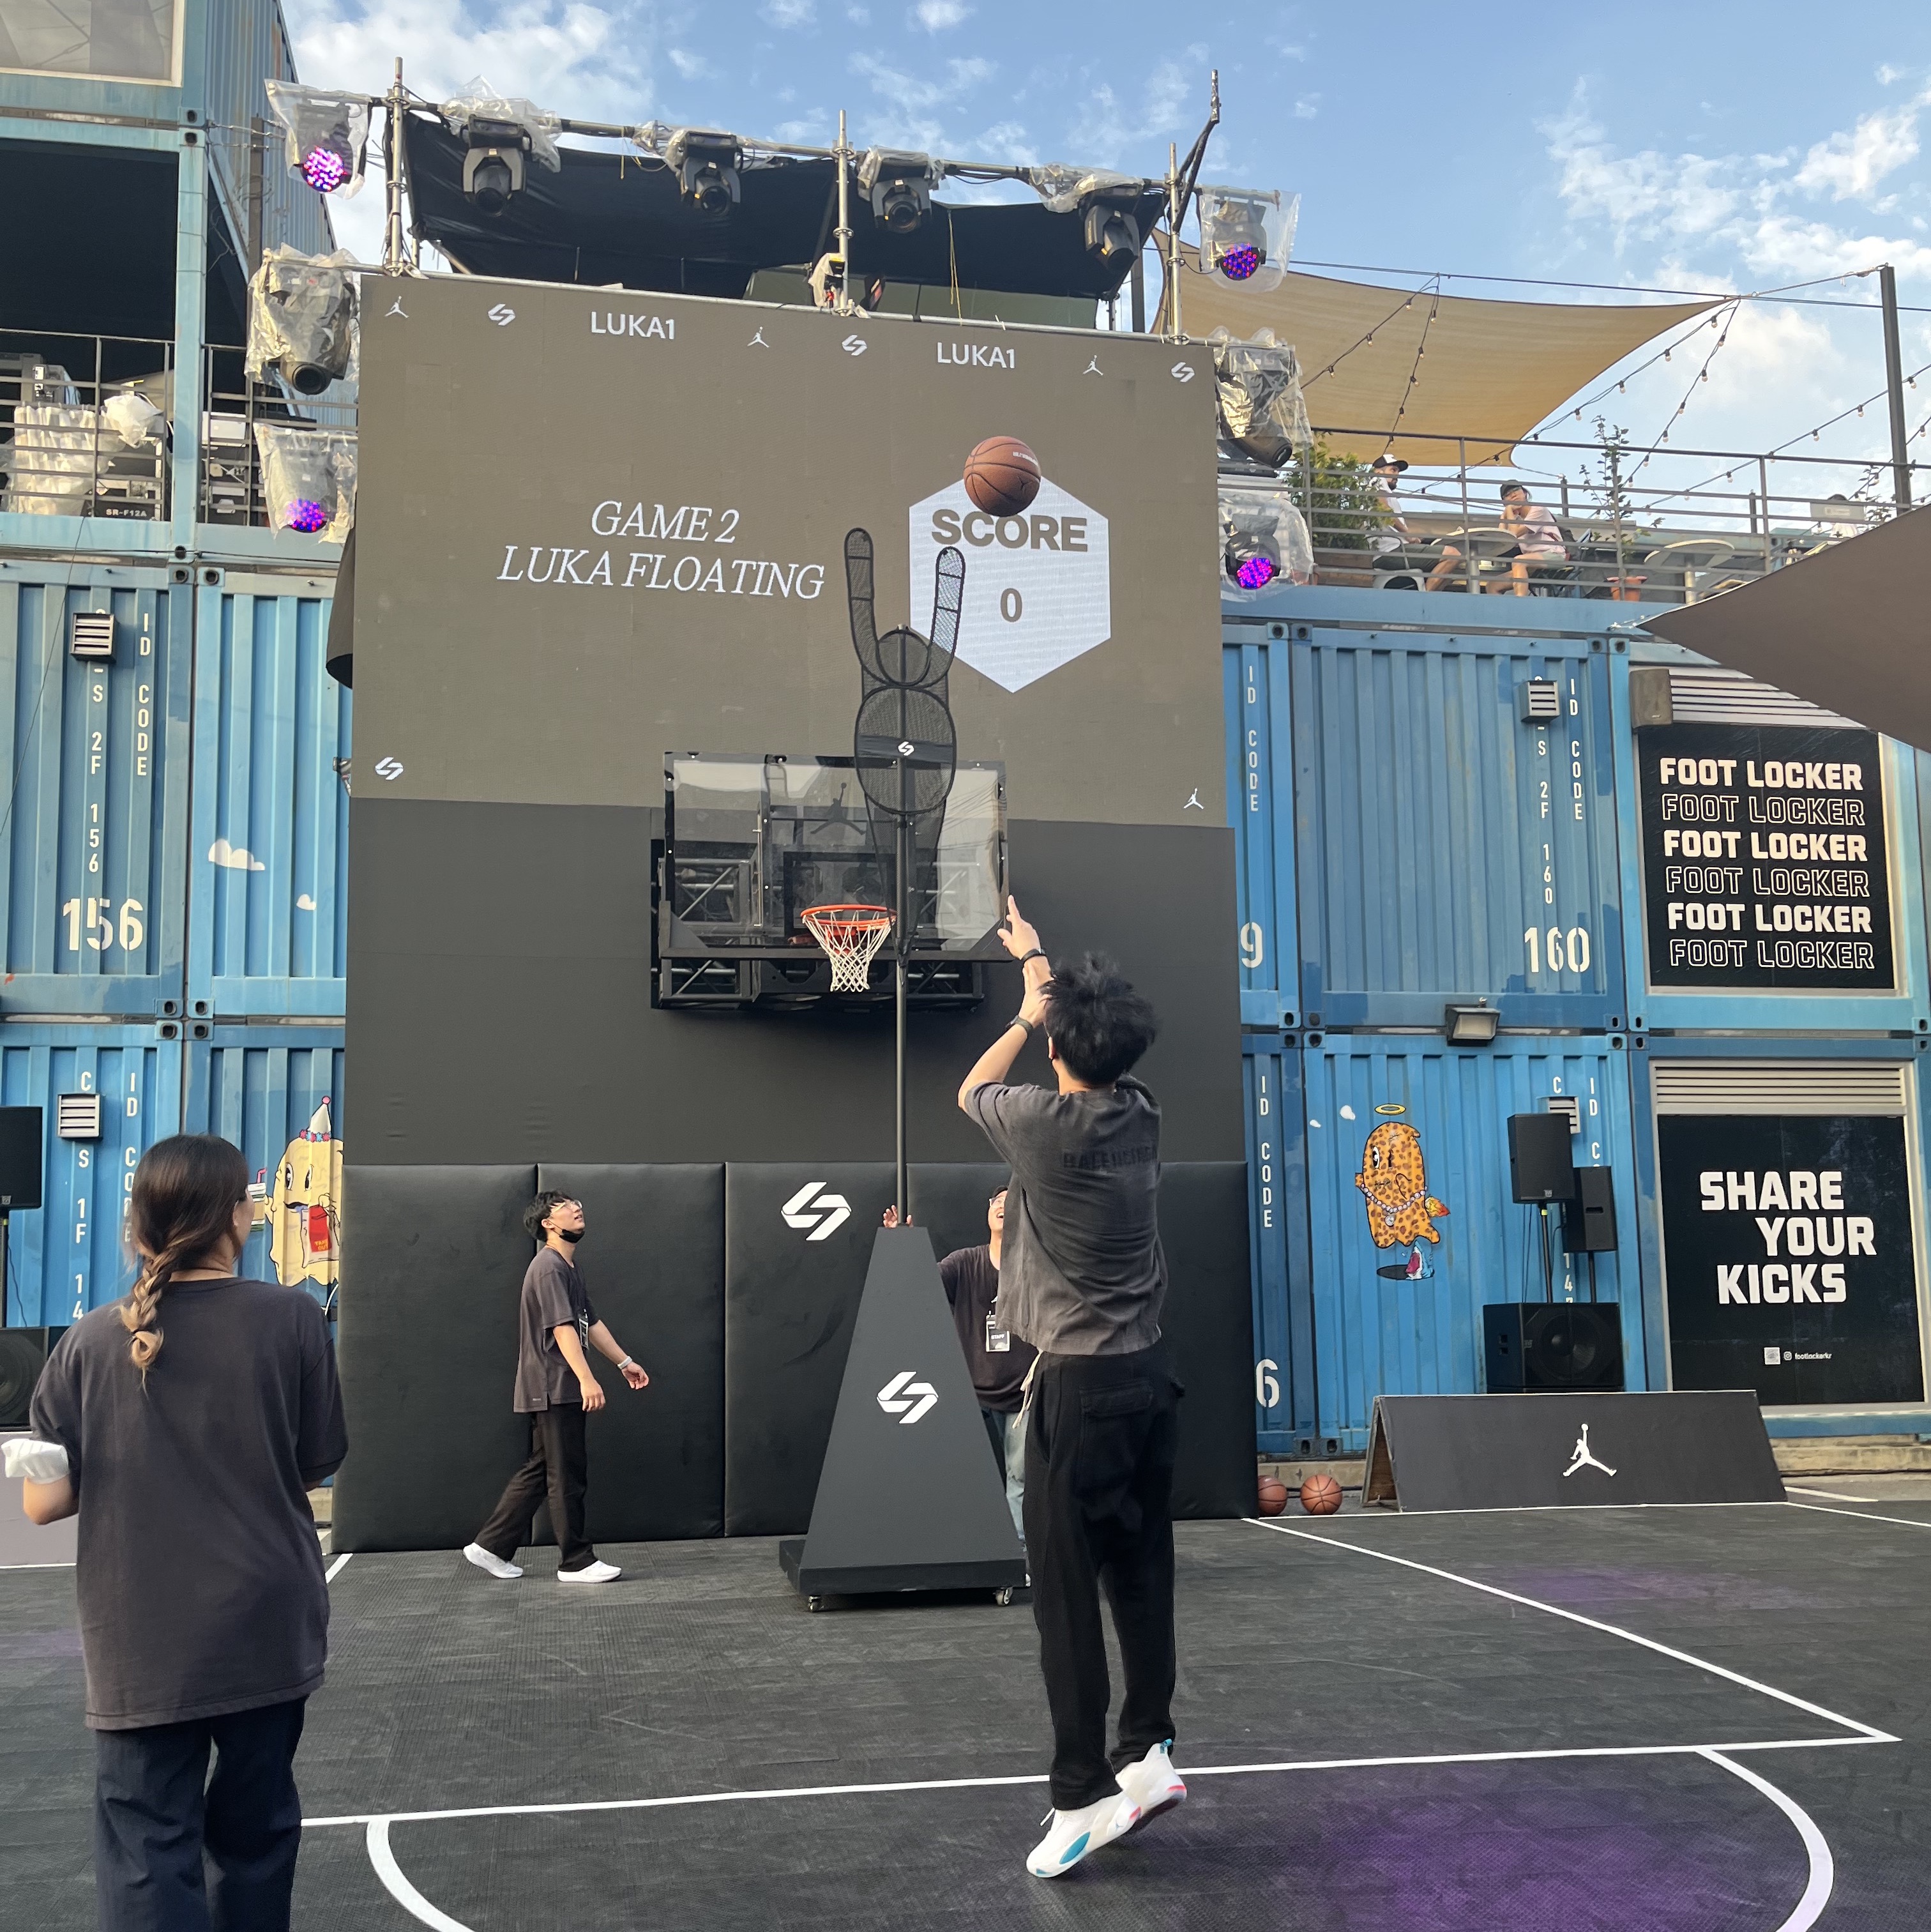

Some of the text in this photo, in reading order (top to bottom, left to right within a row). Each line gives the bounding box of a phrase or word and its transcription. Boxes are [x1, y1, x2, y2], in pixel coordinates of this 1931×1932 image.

[592, 312, 674, 340] LUKA1
[937, 342, 1015, 369] LUKA1
[591, 500, 739, 543] GAME 2
[931, 509, 1088, 552] SCORE
[497, 545, 824, 599] LUKA FLOATING
[1000, 588, 1023, 623] 0
[137, 613, 150, 776] ID CODE
[91, 731, 102, 775] 2F
[1247, 666, 1259, 812] ID CODE
[1570, 678, 1583, 820] ID CODE
[1660, 757, 1863, 790] FOOT LOCKER
[1540, 781, 1549, 819] 2F
[1662, 794, 1865, 826] FOOT LOCKER
[89, 803, 100, 872] 156
[1664, 830, 1867, 862] FOOT LOCKER
[1543, 844, 1553, 904] 160
[1666, 866, 1870, 897] FOOT LOCKER
[63, 897, 143, 951] 156
[1668, 902, 1872, 933] FOOT LOCKER
[1240, 922, 1263, 968] 9
[1524, 926, 1590, 973] 160
[1670, 939, 1874, 969] FOOT LOCKER
[126, 1072, 138, 1118] ID
[1589, 1077, 1599, 1116] ID
[1260, 1076, 1273, 1228] ID CODE
[1700, 1171, 1844, 1211] SHARE
[76, 1198, 87, 1244] 1F
[1755, 1217, 1877, 1256] YOUR
[1716, 1263, 1847, 1304] KICKS
[1255, 1358, 1280, 1408] 6
